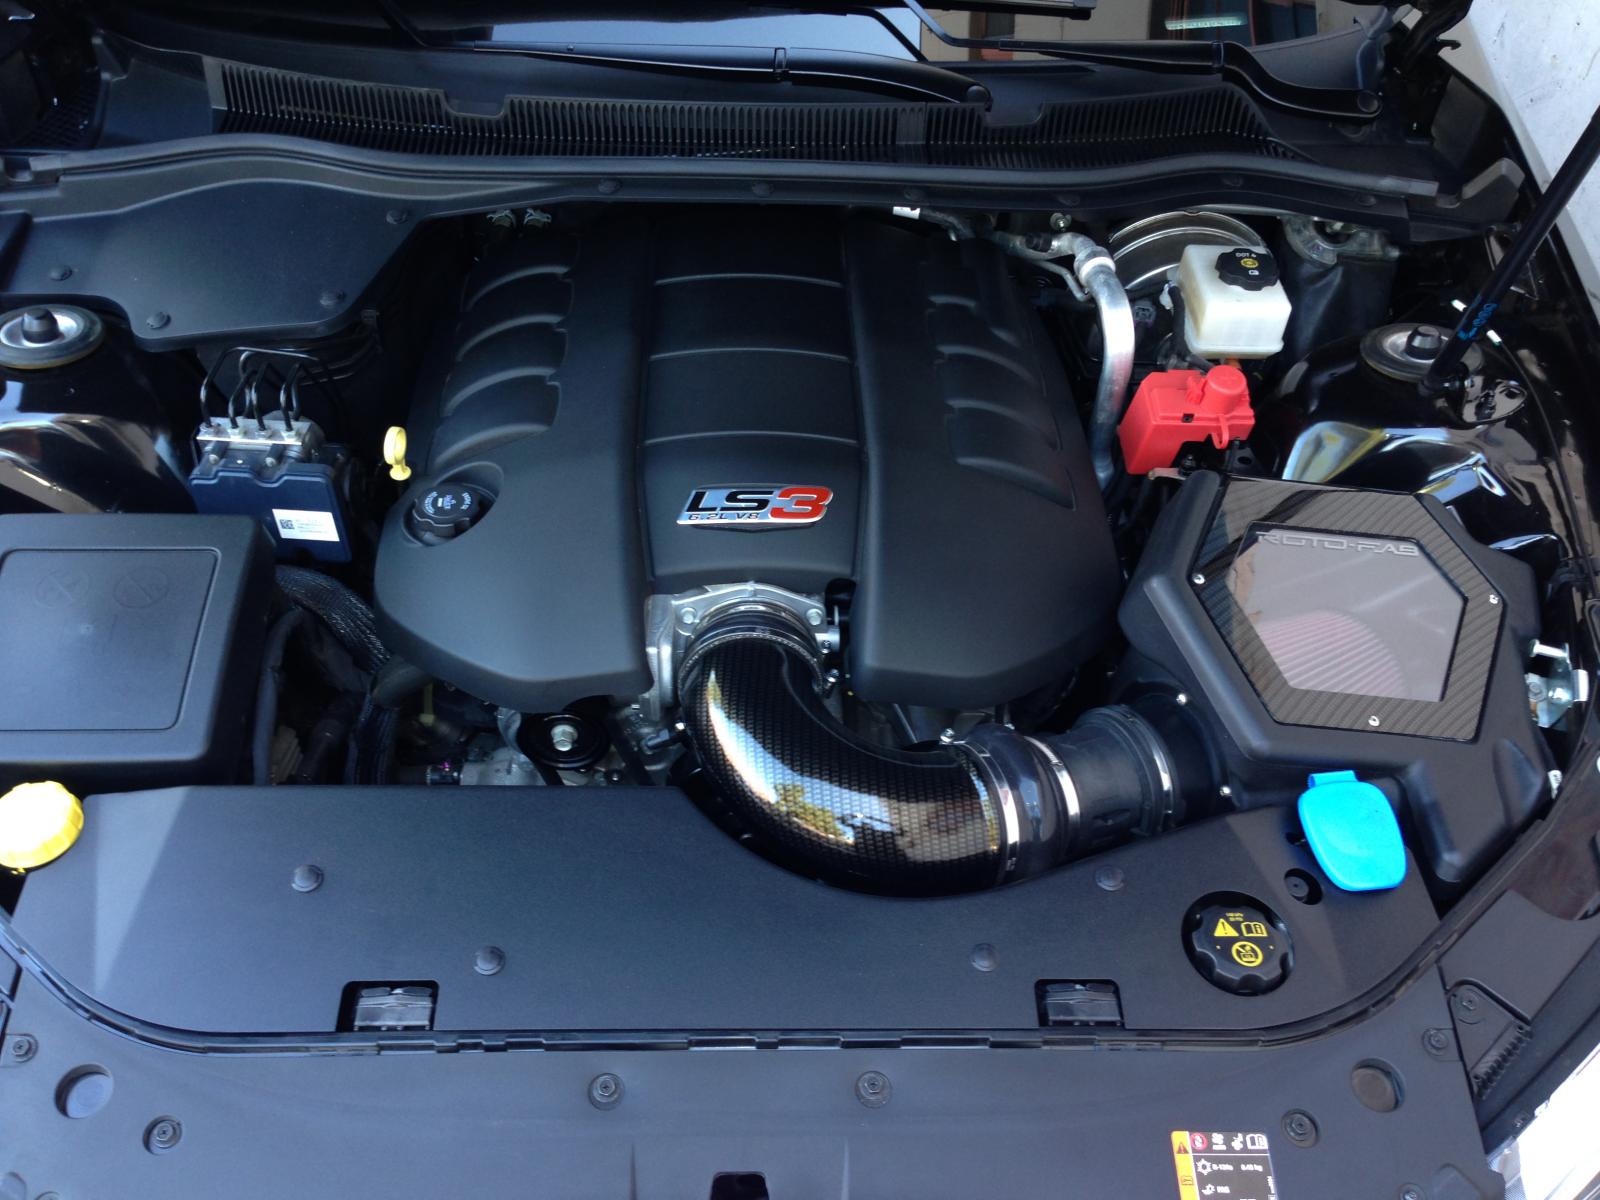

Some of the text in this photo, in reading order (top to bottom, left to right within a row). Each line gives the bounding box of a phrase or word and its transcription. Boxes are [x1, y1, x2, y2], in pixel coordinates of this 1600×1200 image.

[685, 486, 833, 520] LS3
[688, 512, 760, 521] 6.2L V8
[1255, 531, 1420, 557] ROTO-FAB
